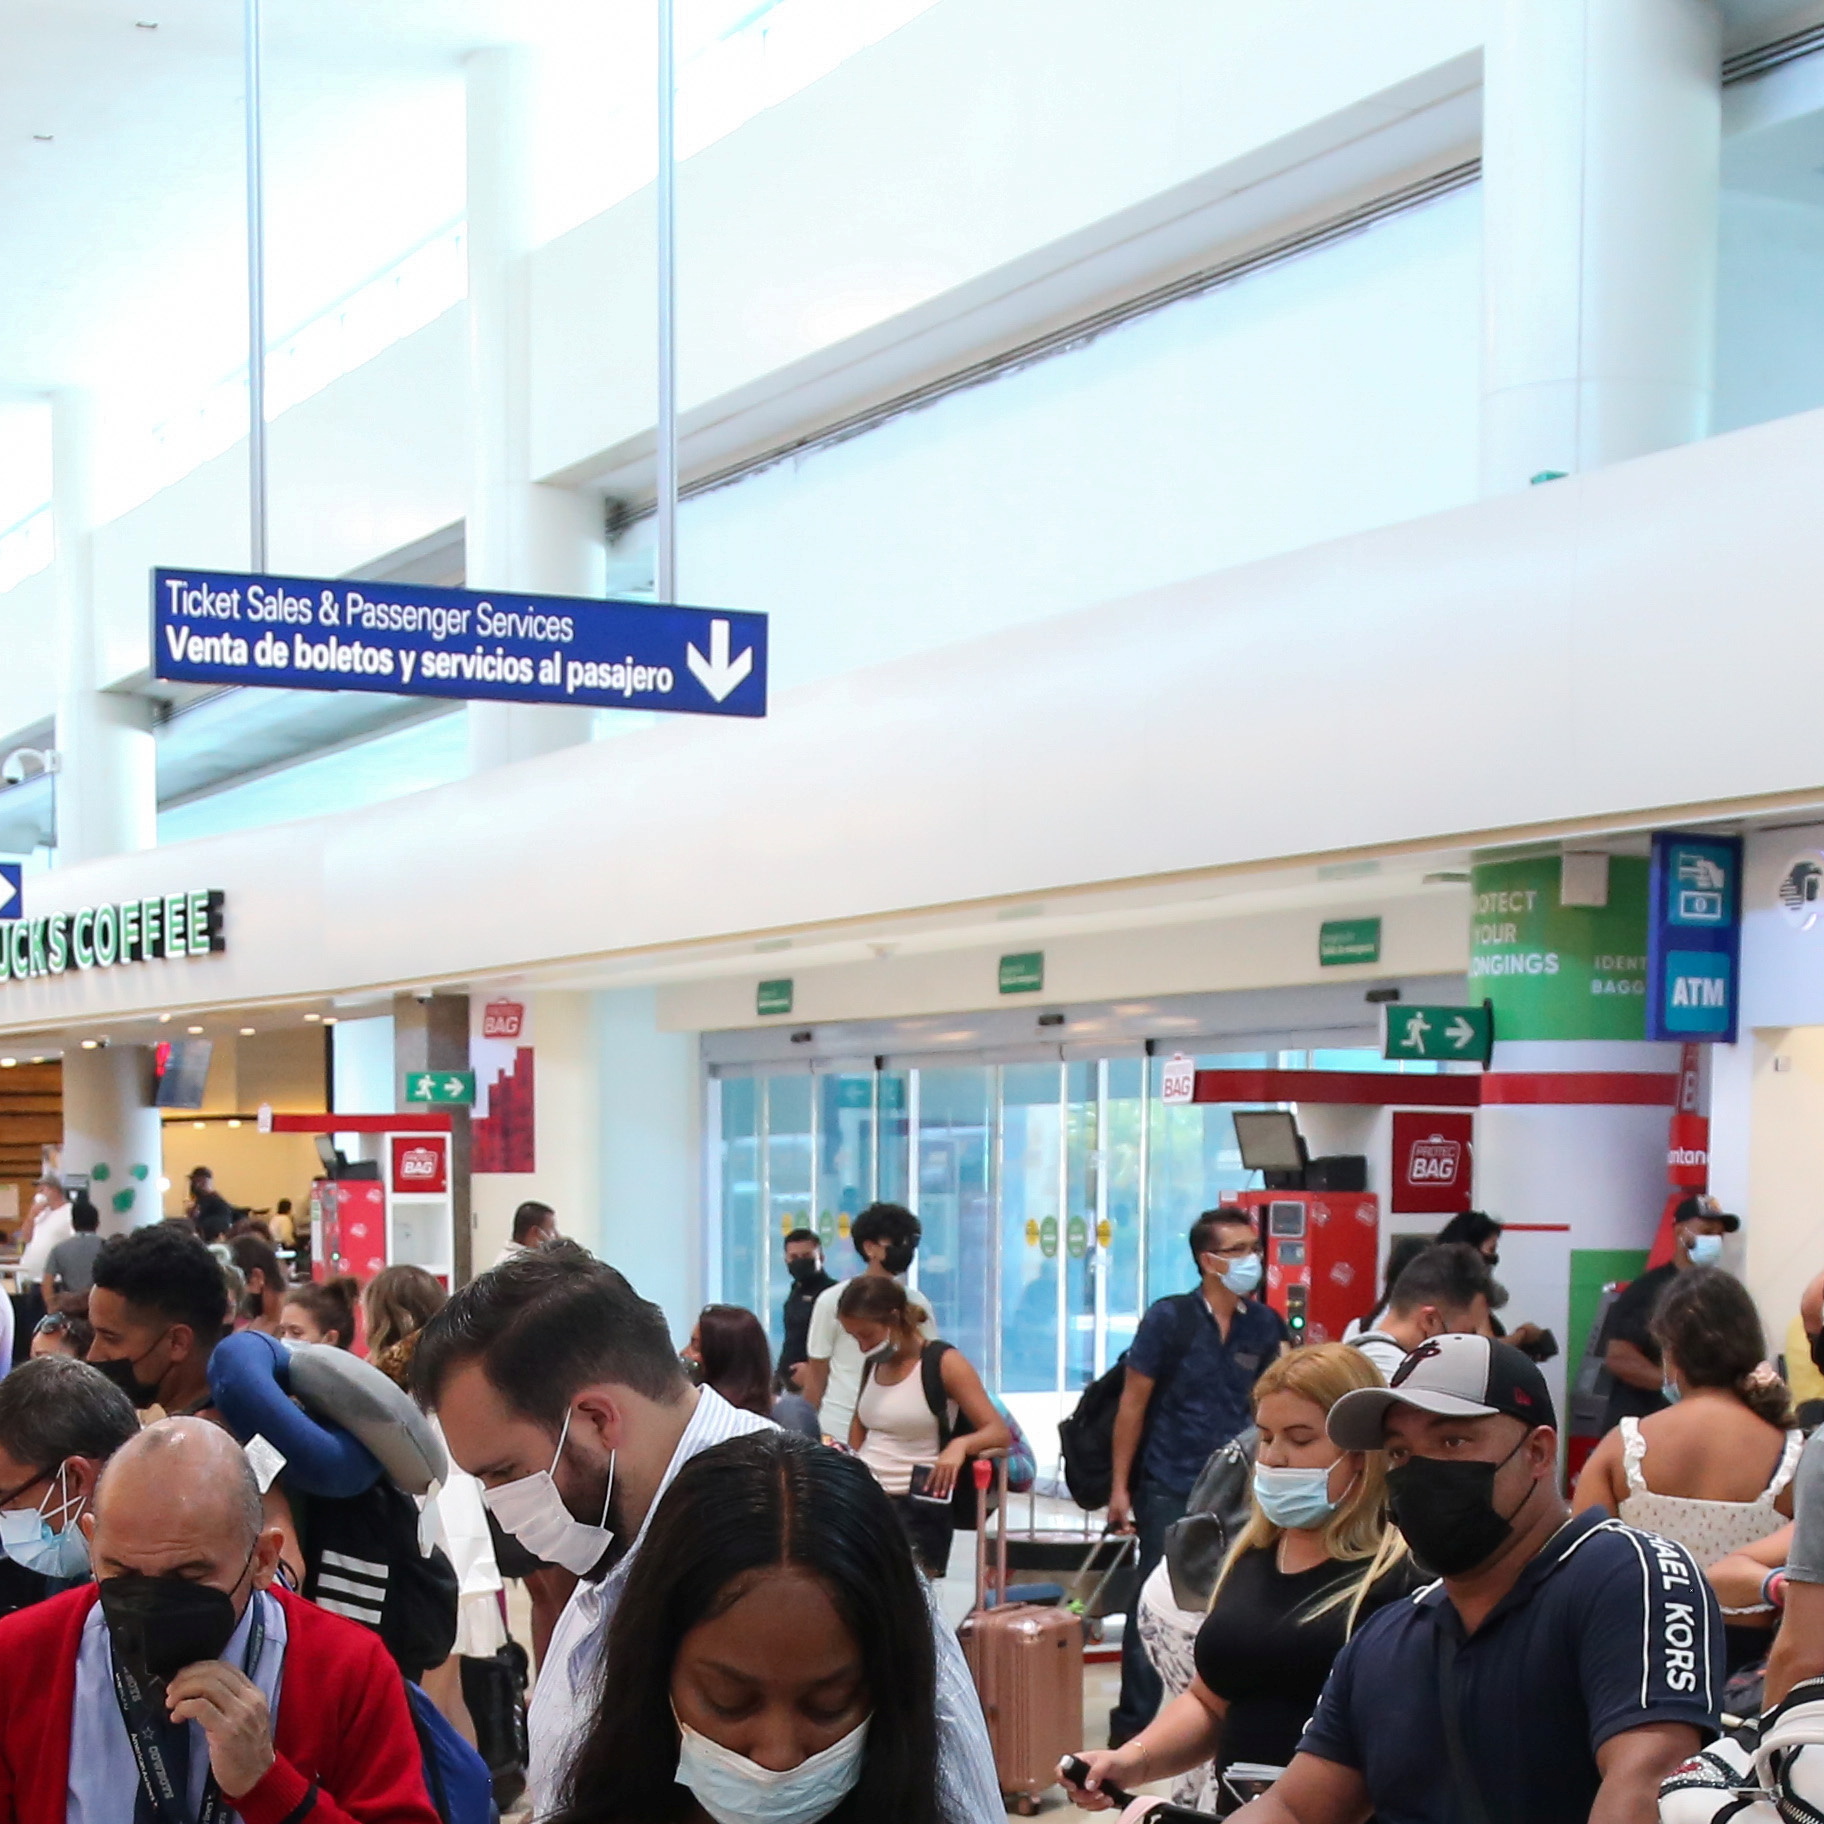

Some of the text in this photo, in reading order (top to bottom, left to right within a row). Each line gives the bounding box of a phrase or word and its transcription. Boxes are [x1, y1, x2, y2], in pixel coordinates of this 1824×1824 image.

[165, 579, 574, 642] Ticket Sales & Passenger Services
[166, 625, 674, 699] Venta de boletos y servicios al pasajero
[72, 886, 212, 971] COFFEE
[1672, 976, 1725, 1007] ATM
[484, 1016, 519, 1034] BAG
[1165, 1076, 1191, 1098] BAG
[1414, 1143, 1456, 1158] PROTEC
[403, 1161, 433, 1174] BAG
[1411, 1157, 1455, 1180] BAG
[1663, 1602, 1697, 1694] KORS
